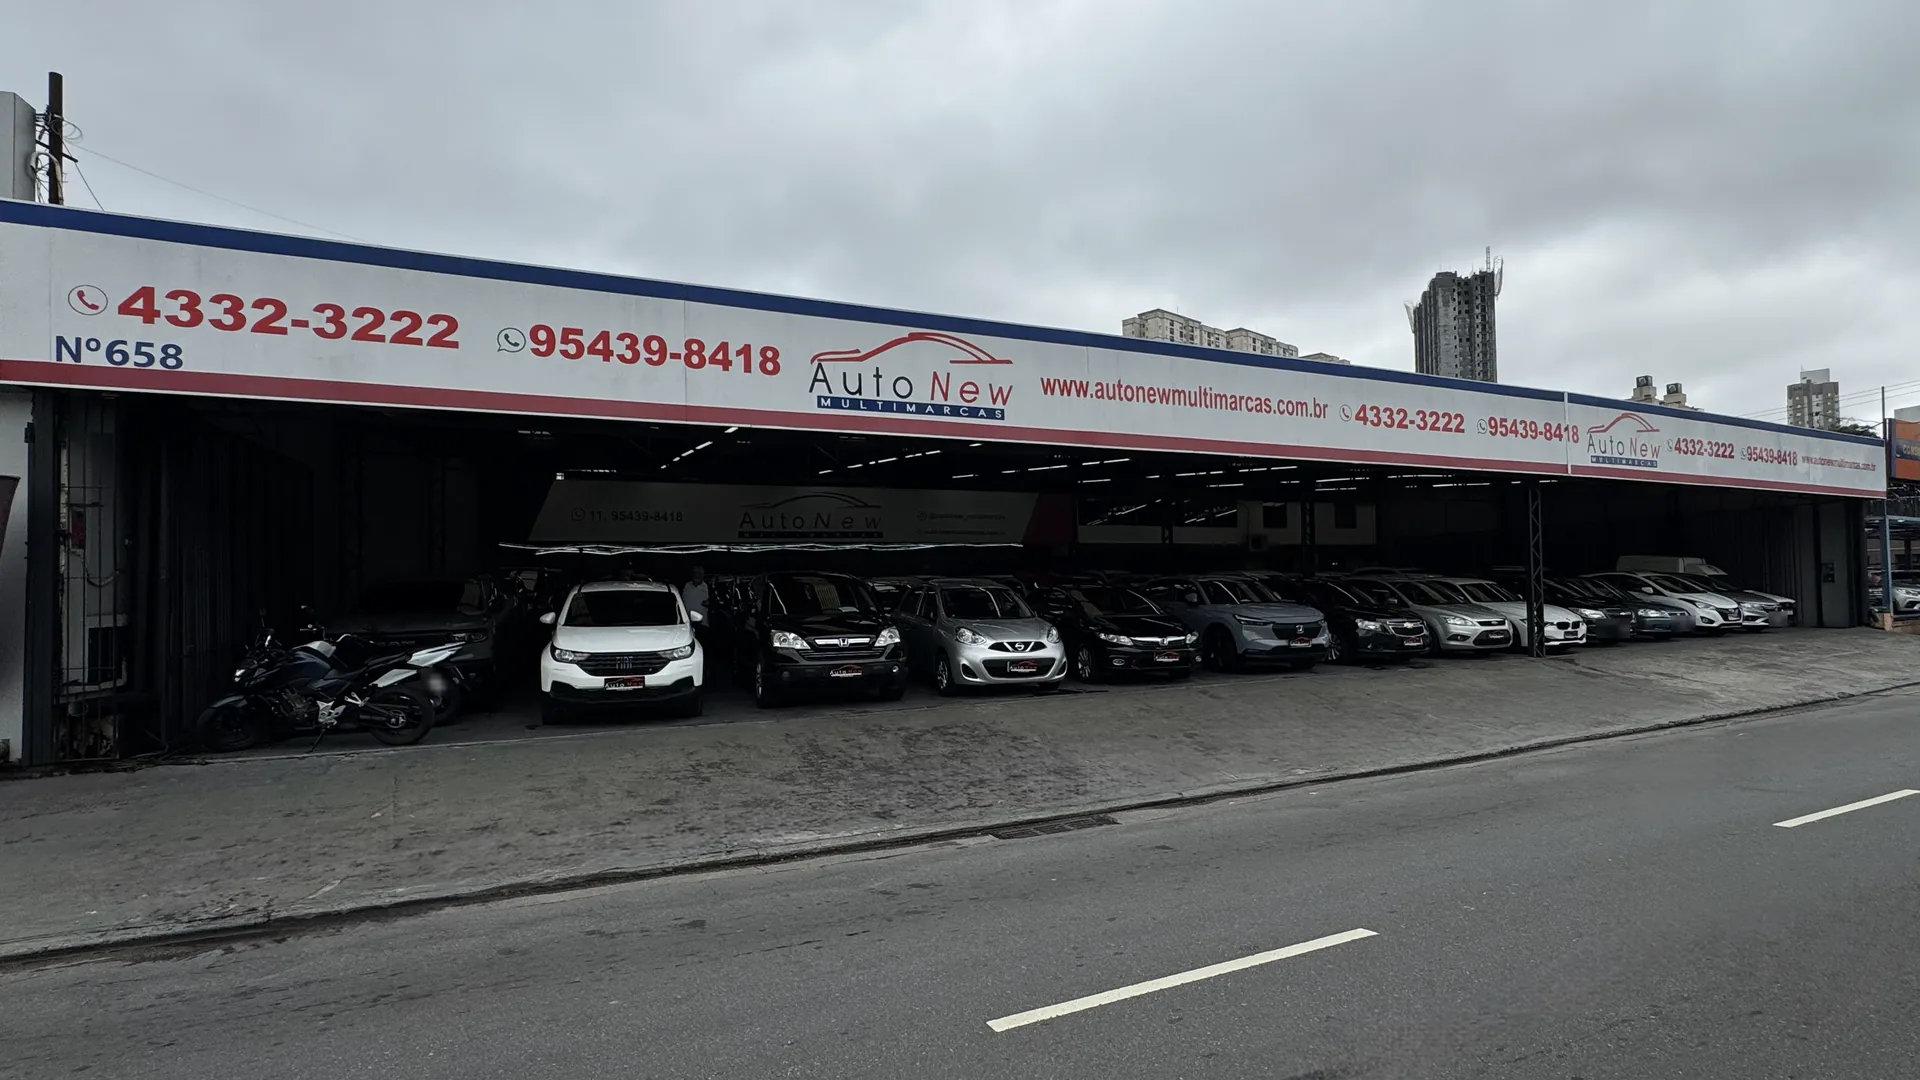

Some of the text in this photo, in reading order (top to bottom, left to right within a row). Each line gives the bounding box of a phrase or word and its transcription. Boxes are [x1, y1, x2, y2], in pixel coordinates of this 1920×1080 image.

[117, 286, 459, 349] 4332-3222
[529, 323, 781, 376] 95439-8418
[809, 362, 1014, 407] Auto New
[820, 397, 1002, 419] MULTIMARCAS
[1040, 376, 1329, 420] www.autonewmultimarcas.com.br
[1354, 404, 1465, 434] 4332-3222
[1487, 416, 1579, 444] 95439-8418
[1587, 433, 1661, 459] Auto New
[1674, 437, 1735, 459] 4332-3222
[1747, 446, 1798, 467] 95439-8418
[1591, 456, 1657, 467] MULTIMARCAS
[611, 510, 683, 522] 95439-8418
[740, 511, 881, 529] Auto New
